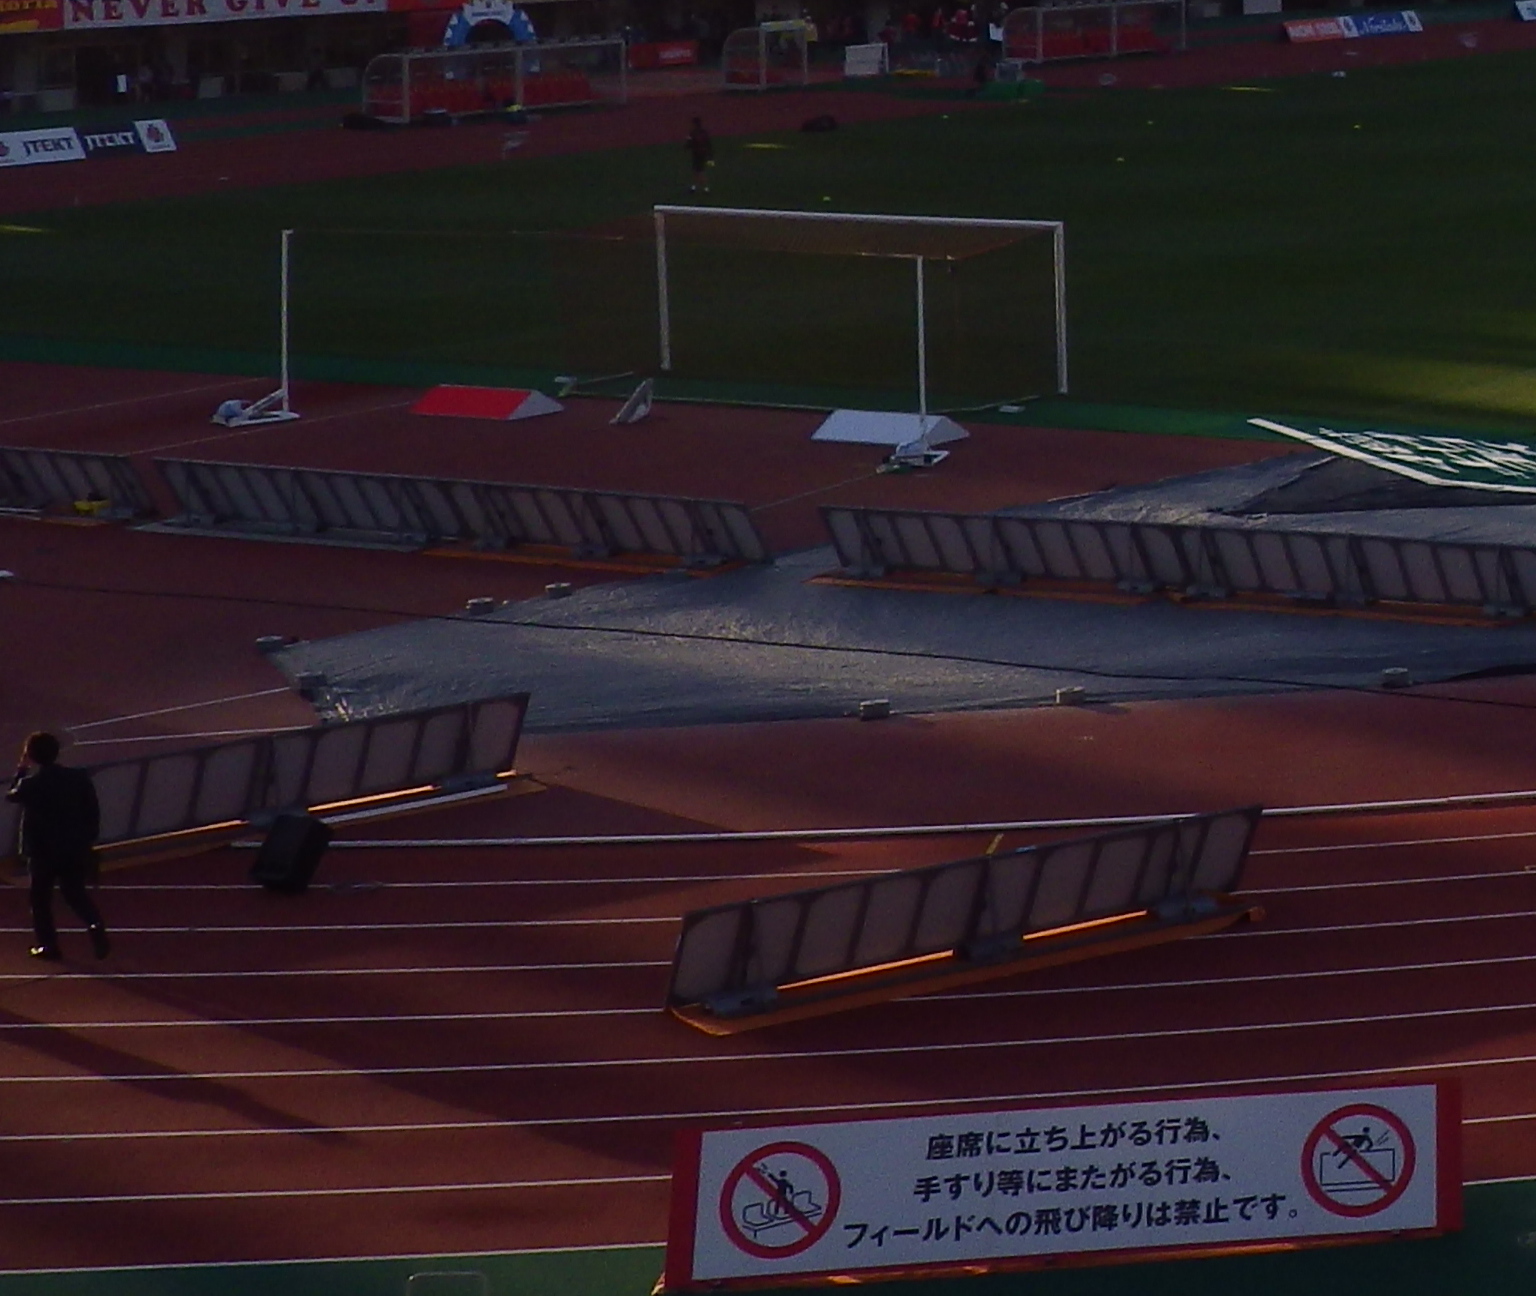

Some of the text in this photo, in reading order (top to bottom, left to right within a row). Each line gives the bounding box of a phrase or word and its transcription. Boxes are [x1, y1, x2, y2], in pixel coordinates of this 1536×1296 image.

[22, 136, 75, 157] JTEKT
[84, 131, 136, 151] JTEKT
[926, 1116, 1222, 1162] 座席に立ち上がる行為、
[913, 1157, 1232, 1203] 手すり等にまたがる行為、
[844, 1193, 1300, 1249] フィールドへの飛び降りは禁止です。
